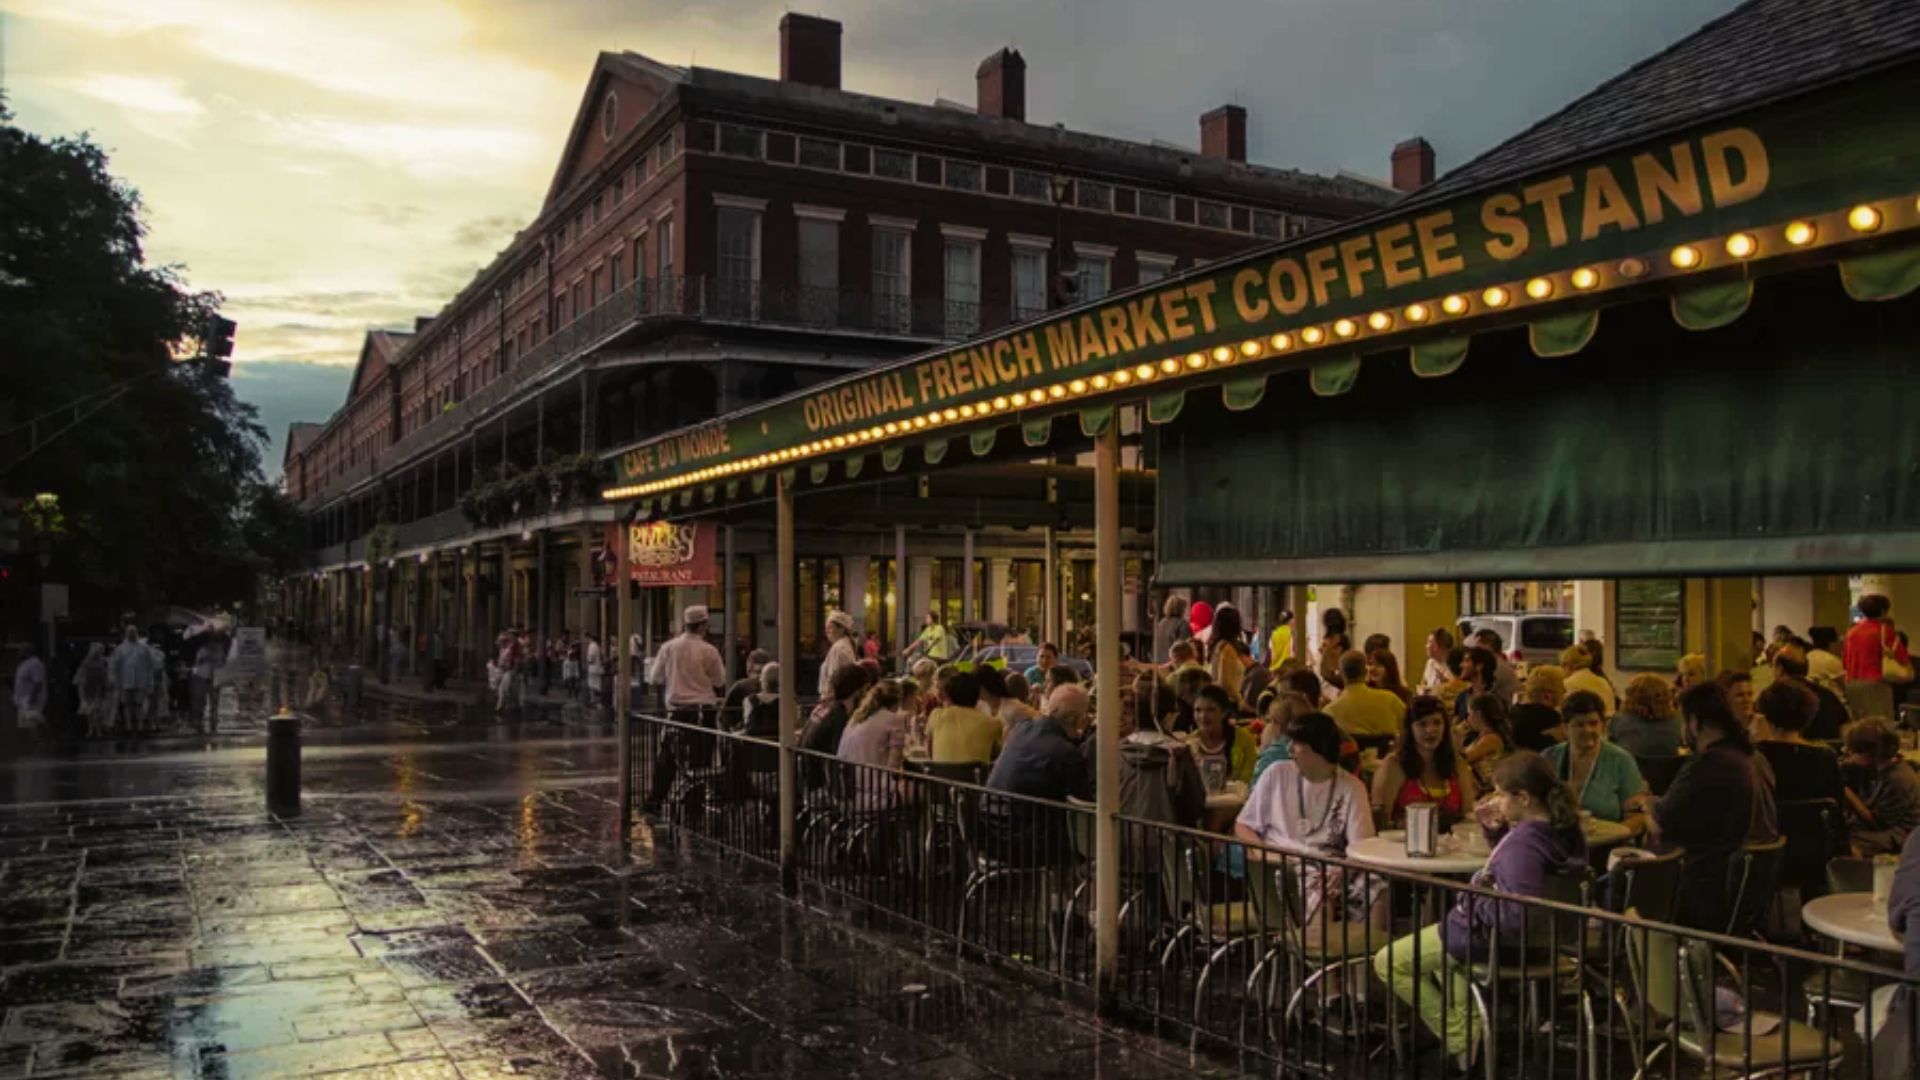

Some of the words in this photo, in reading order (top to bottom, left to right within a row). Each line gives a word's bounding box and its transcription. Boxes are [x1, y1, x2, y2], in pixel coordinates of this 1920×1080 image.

[624, 448, 655, 478] CAFE
[658, 438, 676, 469] DU
[678, 423, 731, 463] MONDE
[804, 373, 913, 432] ORIGINAL
[915, 333, 1043, 404] FRENCH
[1046, 280, 1217, 371] MARKET
[1233, 209, 1464, 323] COFFEE
[1484, 127, 1770, 261] STAND
